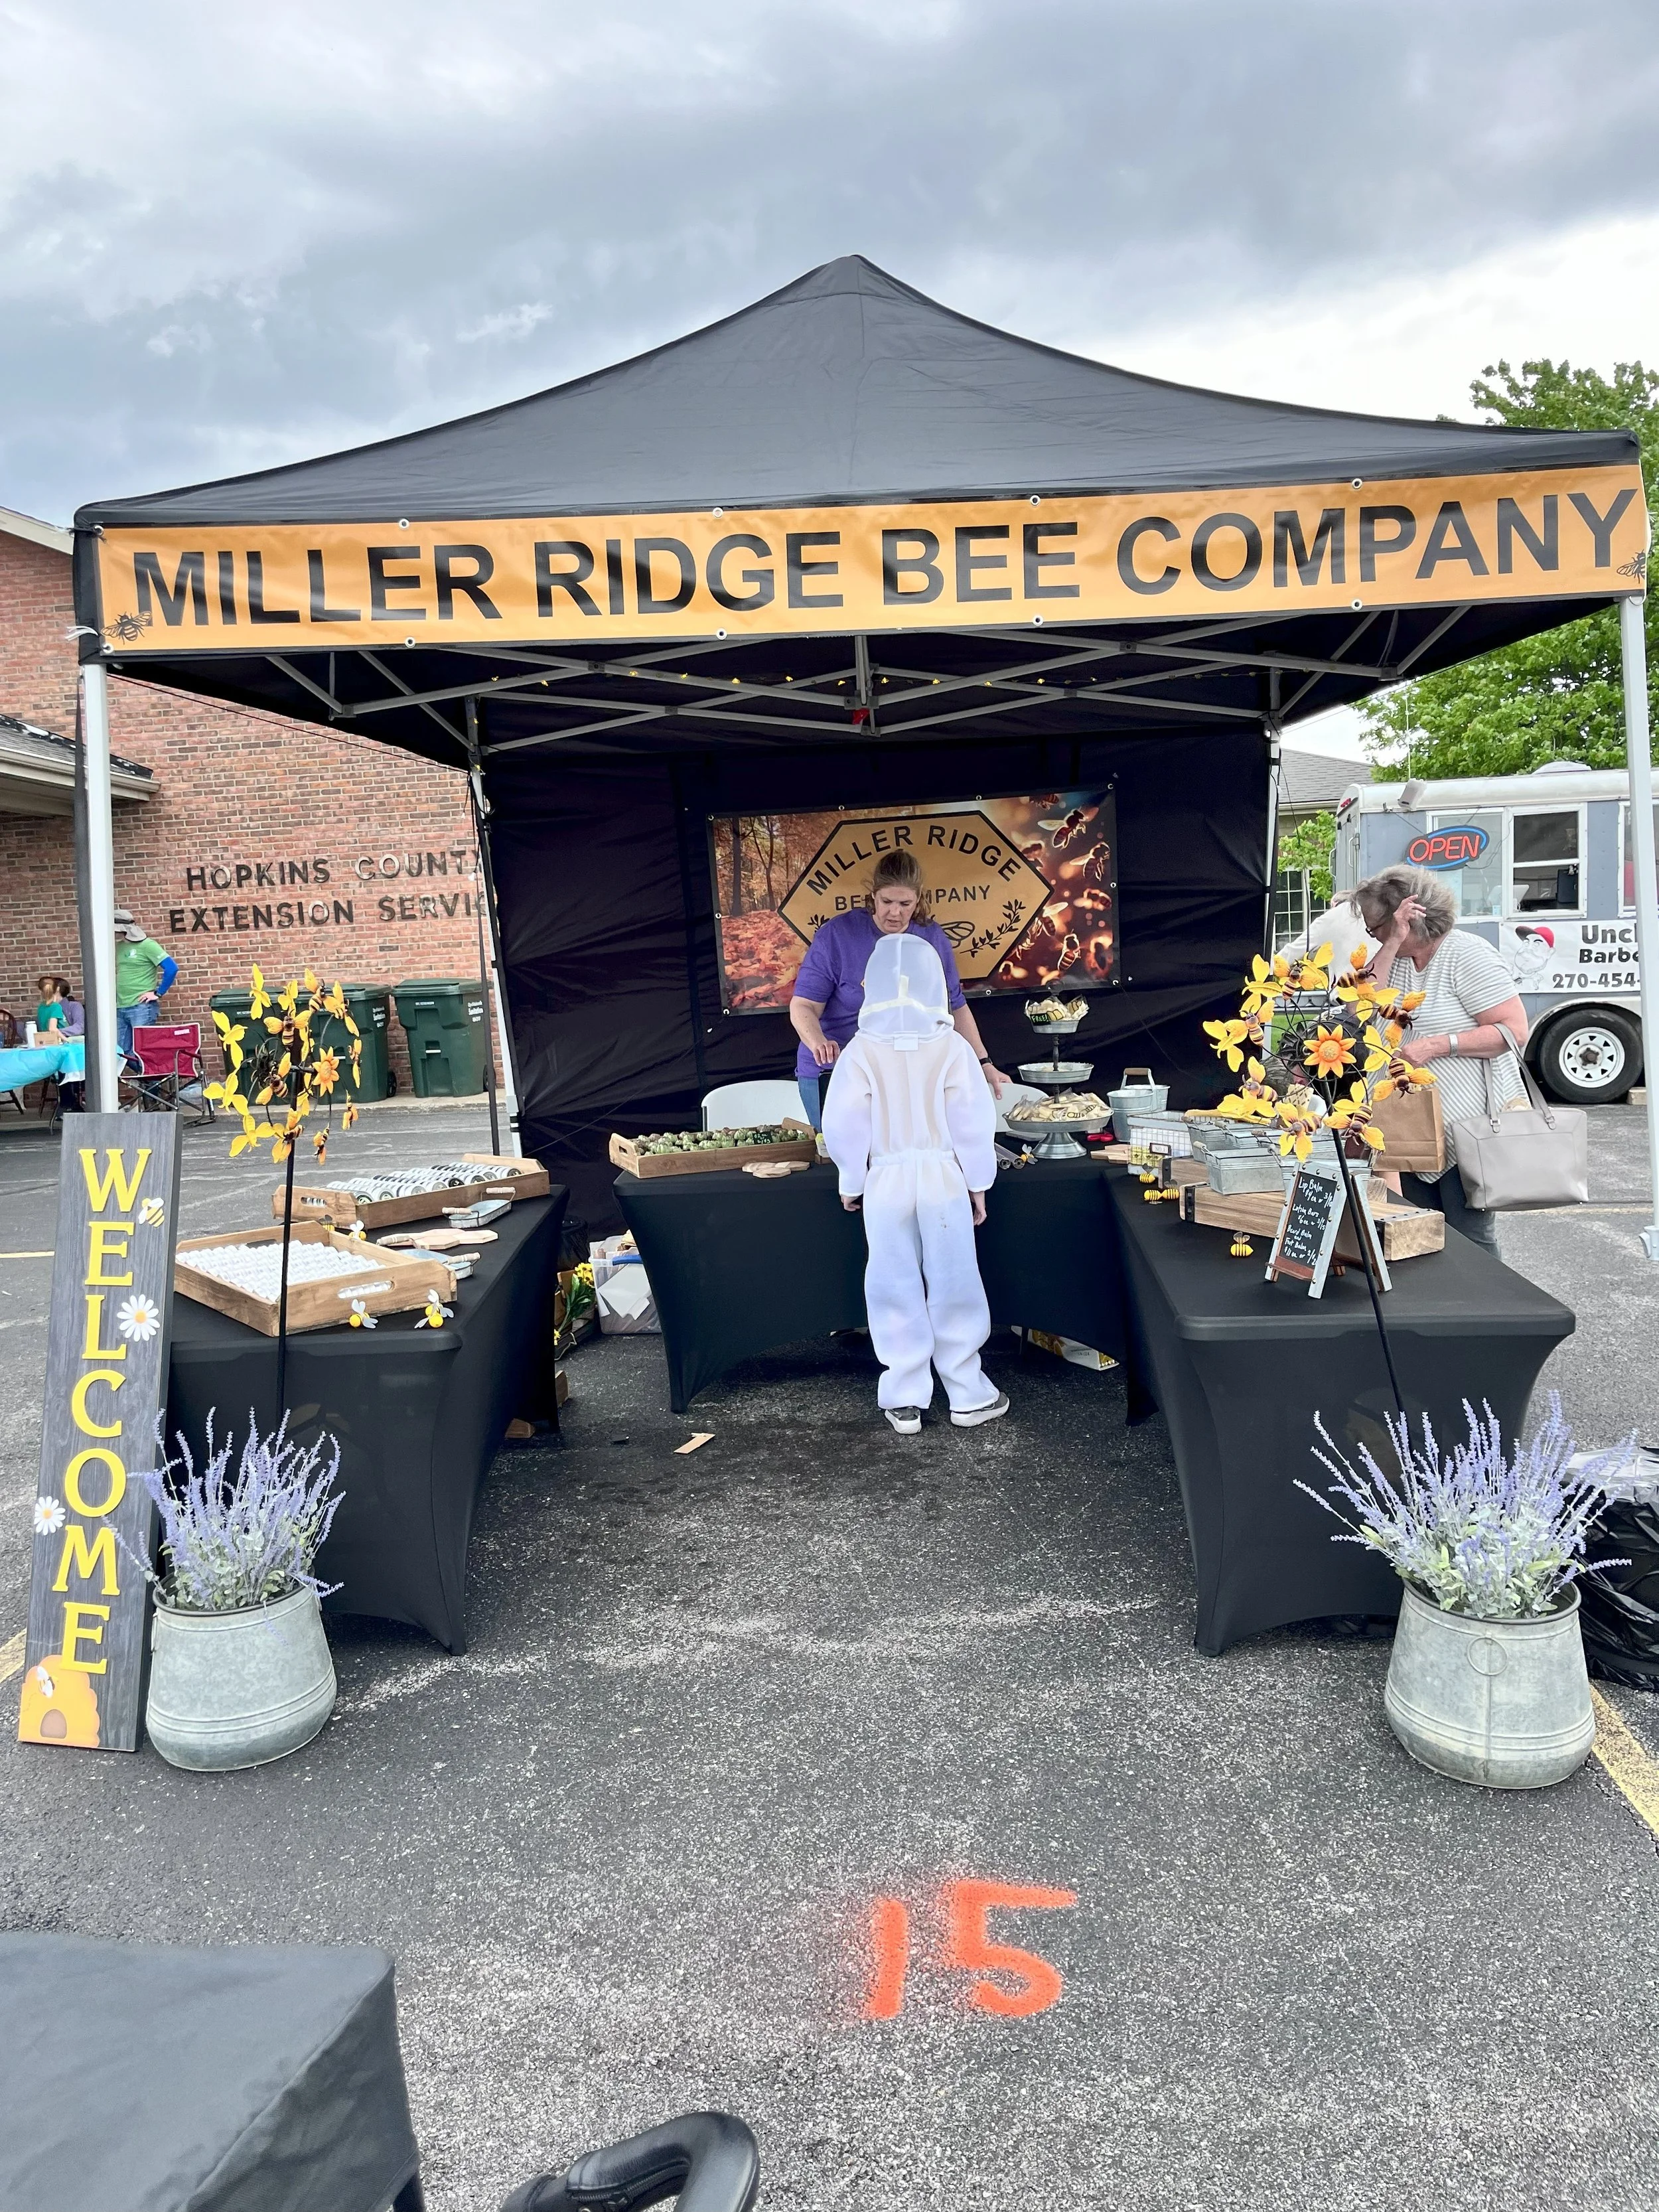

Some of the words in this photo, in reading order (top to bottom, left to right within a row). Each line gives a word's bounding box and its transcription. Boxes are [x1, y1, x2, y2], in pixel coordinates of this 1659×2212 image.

[133, 544, 502, 627] MILLER
[534, 531, 843, 618] RIDGE
[881, 522, 1080, 605] BEE
[1117, 488, 1638, 595] COMPANY
[806, 826, 914, 896] MILLER
[927, 824, 1021, 881] RIDGE
[1409, 835, 1481, 863] OPEN
[186, 858, 330, 891] HOPKINS
[169, 900, 354, 932] EXTENSION
[378, 891, 486, 921] SERVIC
[1031, 1014, 1049, 1023] FREE!
[1298, 1177, 1308, 1193] Lip
[1309, 1179, 1323, 1193] Balm
[1292, 1203, 1307, 1215] Lotion
[1307, 1208, 1319, 1217] Bars
[1287, 1224, 1301, 1235] Beard
[1301, 1229, 1312, 1240] Balm
[1294, 1241, 1307, 1251] Balm
[52, 1149, 153, 1675] WELCOME
[865, 1880, 1078, 2020] 15
